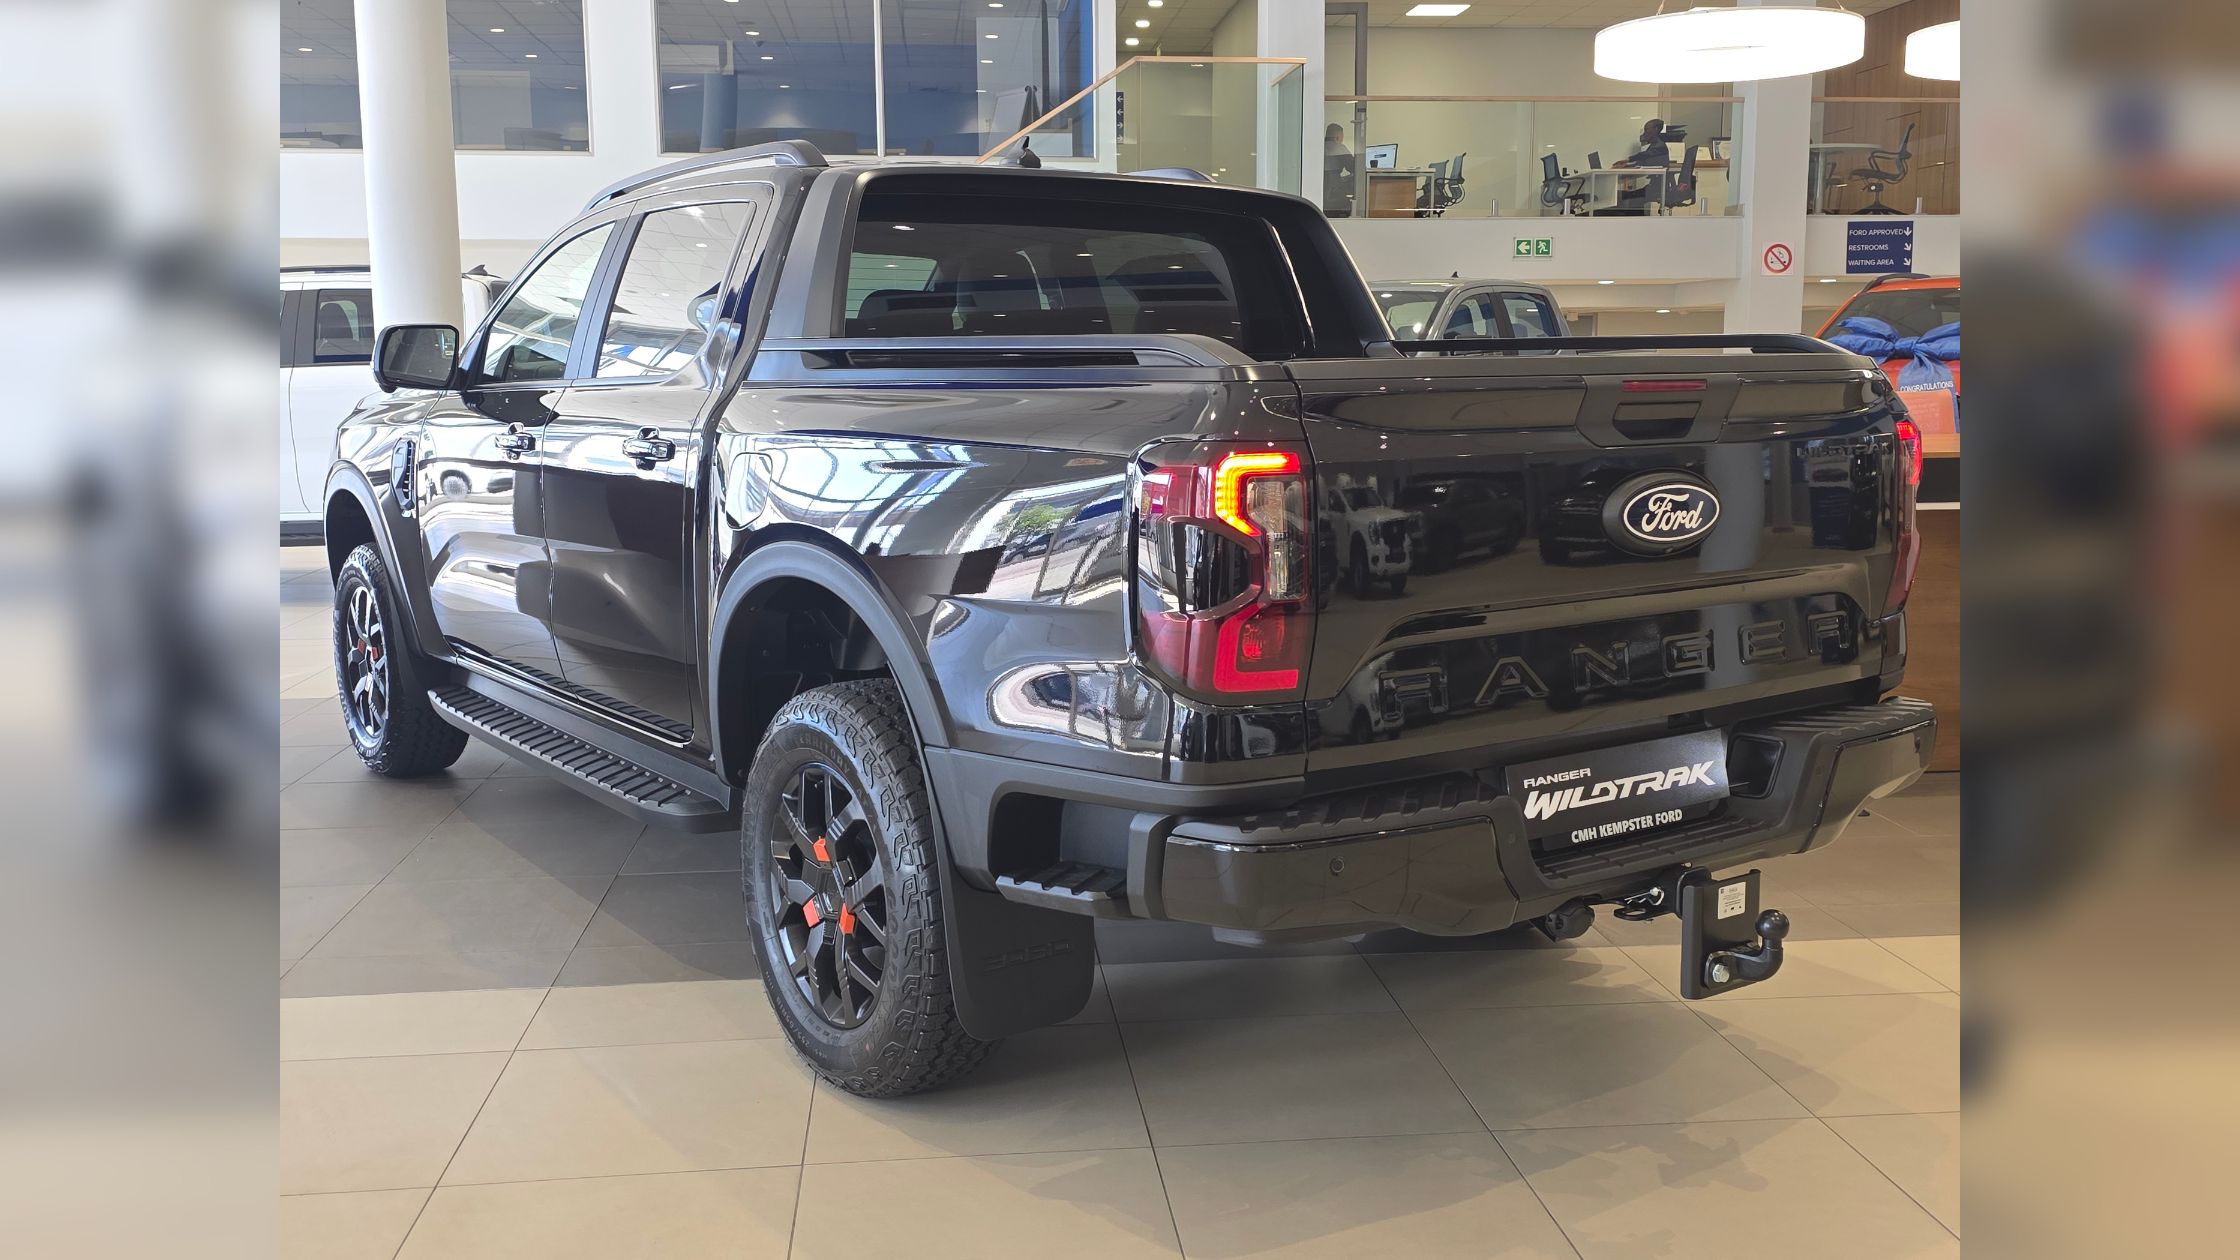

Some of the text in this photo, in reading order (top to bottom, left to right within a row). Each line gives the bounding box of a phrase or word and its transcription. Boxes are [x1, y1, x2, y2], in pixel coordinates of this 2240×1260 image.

[1868, 228, 1904, 236] APPROVED
[1876, 258, 1894, 266] AREA
[1900, 380, 1954, 392] CONGRATULATIONS
[1641, 493, 1704, 532] Ford
[1377, 611, 1850, 723] RANGER
[1523, 767, 1592, 789] RANGER
[1523, 760, 1717, 821] WILDTRAK
[1571, 808, 1683, 844] CMH KEMPSTER FORD
